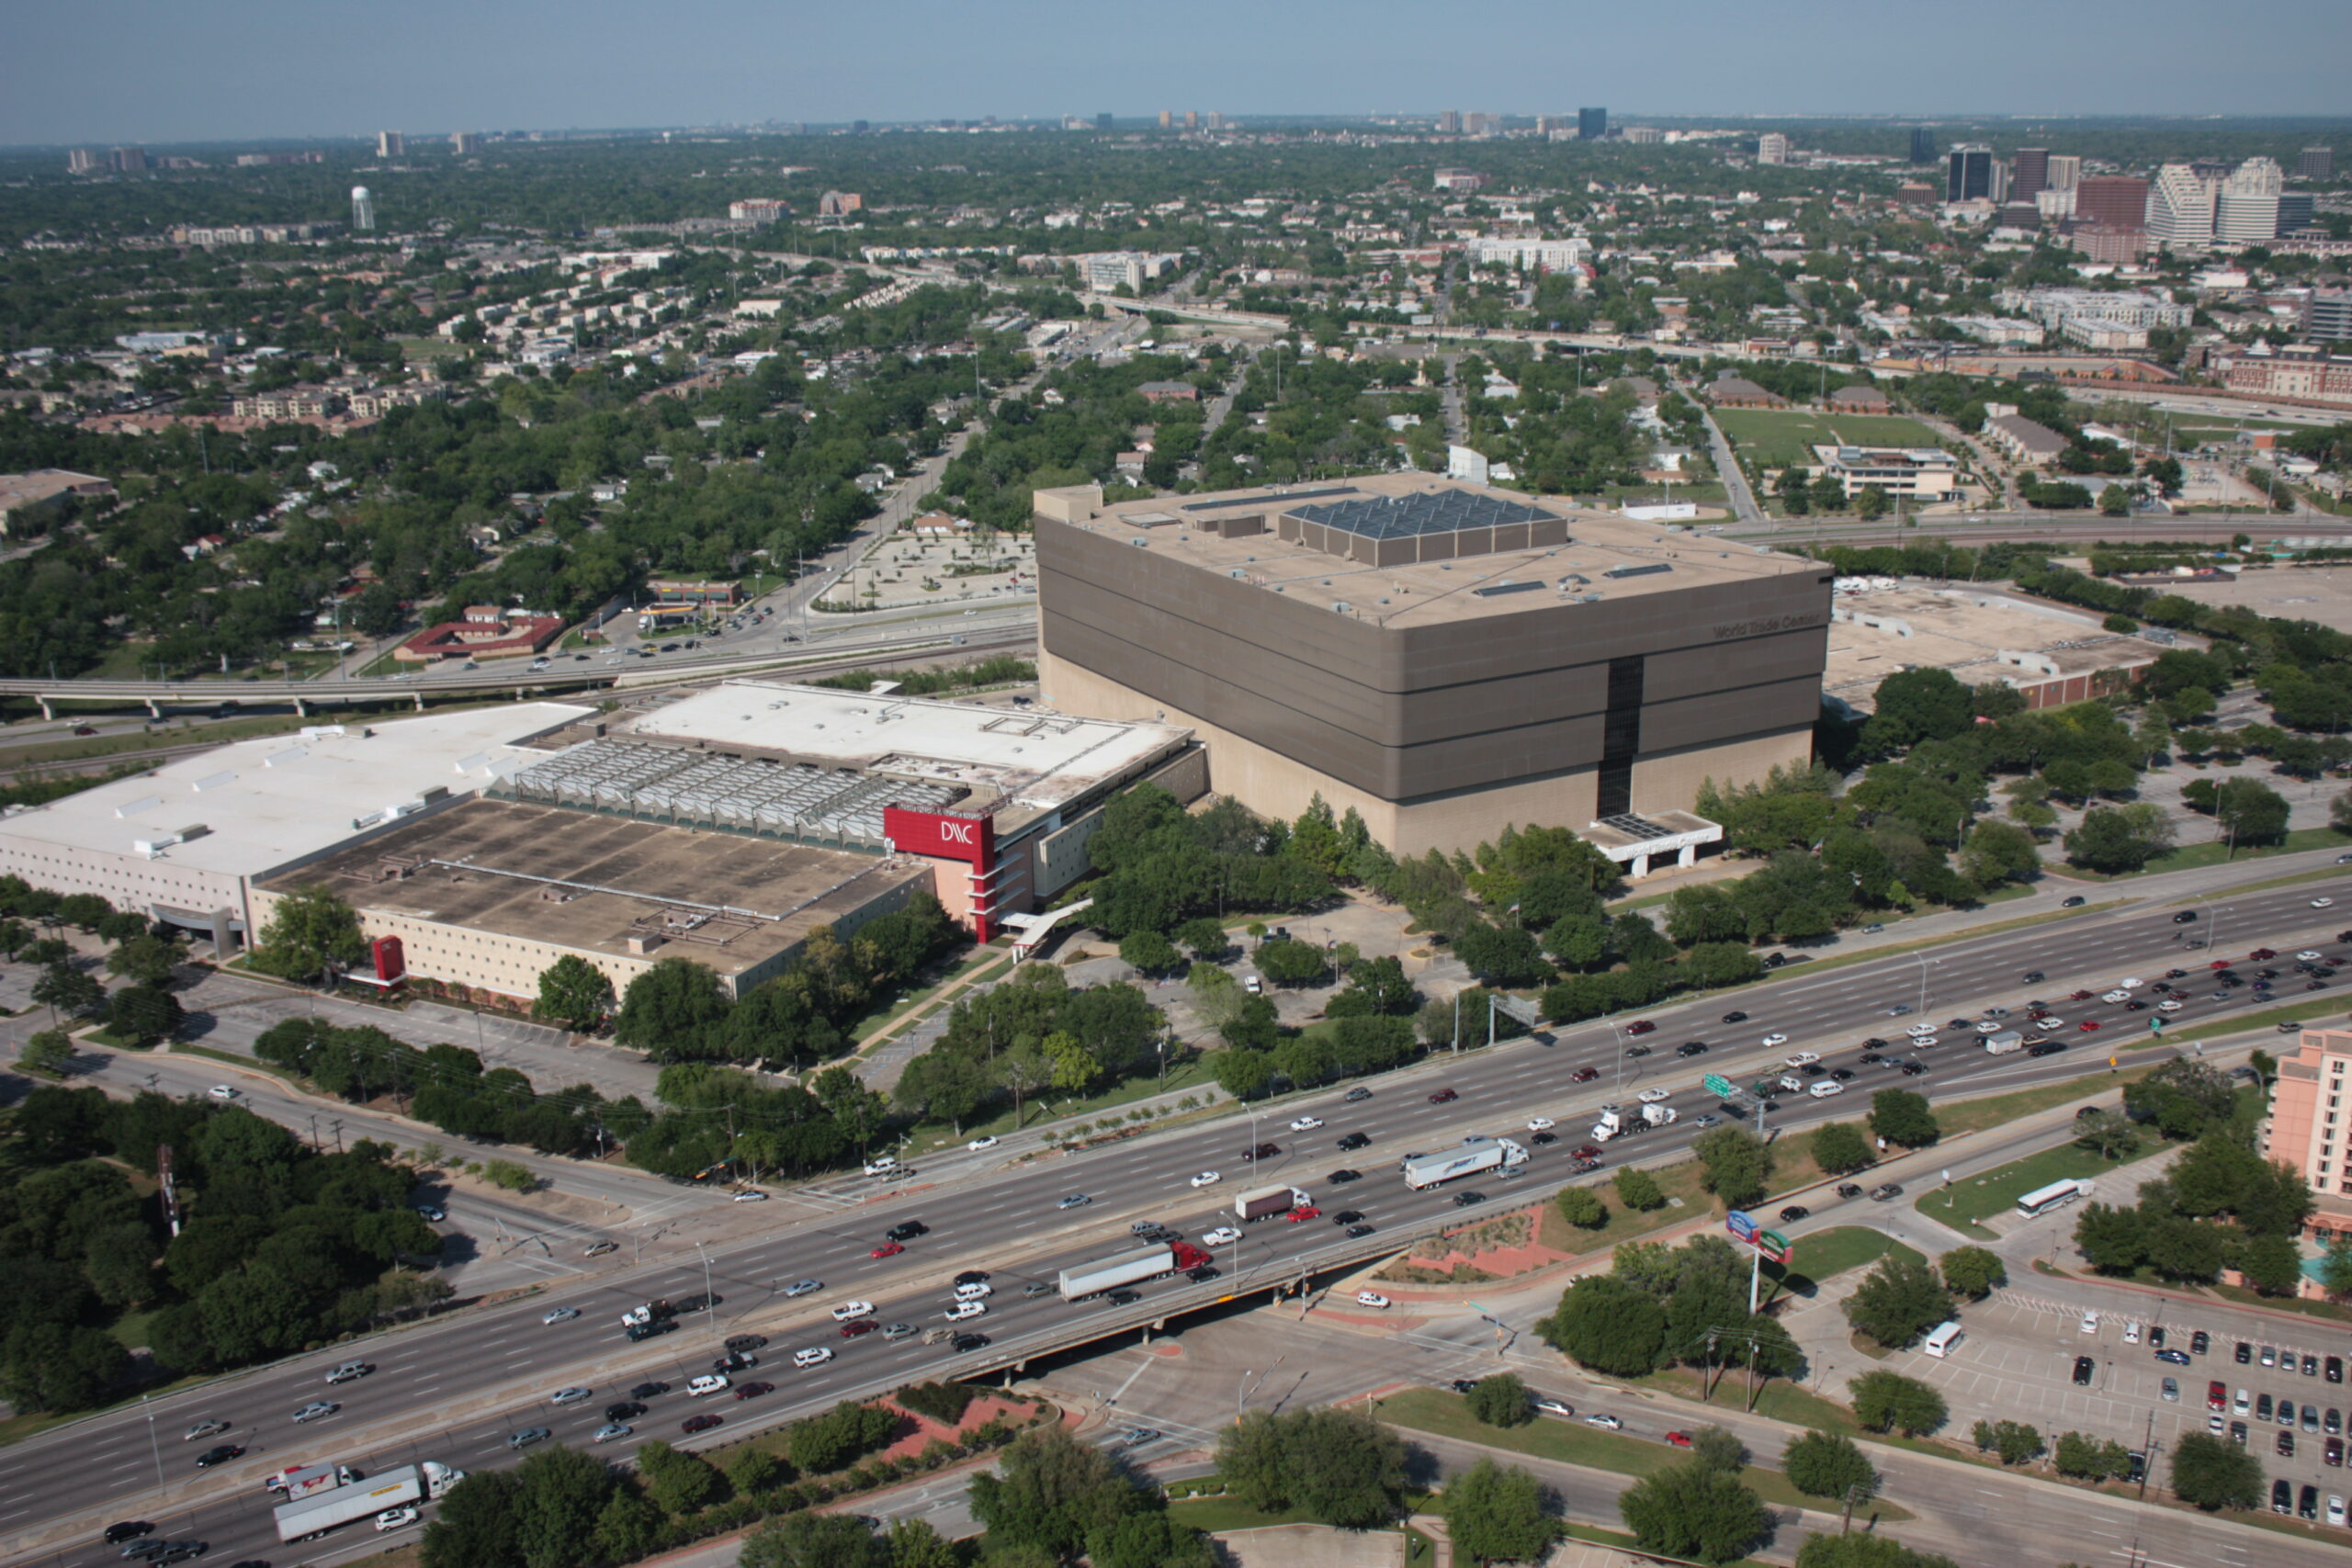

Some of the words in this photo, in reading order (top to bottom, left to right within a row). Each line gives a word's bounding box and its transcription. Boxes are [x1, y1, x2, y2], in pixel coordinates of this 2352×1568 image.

[1713, 623, 1747, 638] World
[1748, 618, 1780, 634] Trade
[1781, 614, 1820, 629] Center
